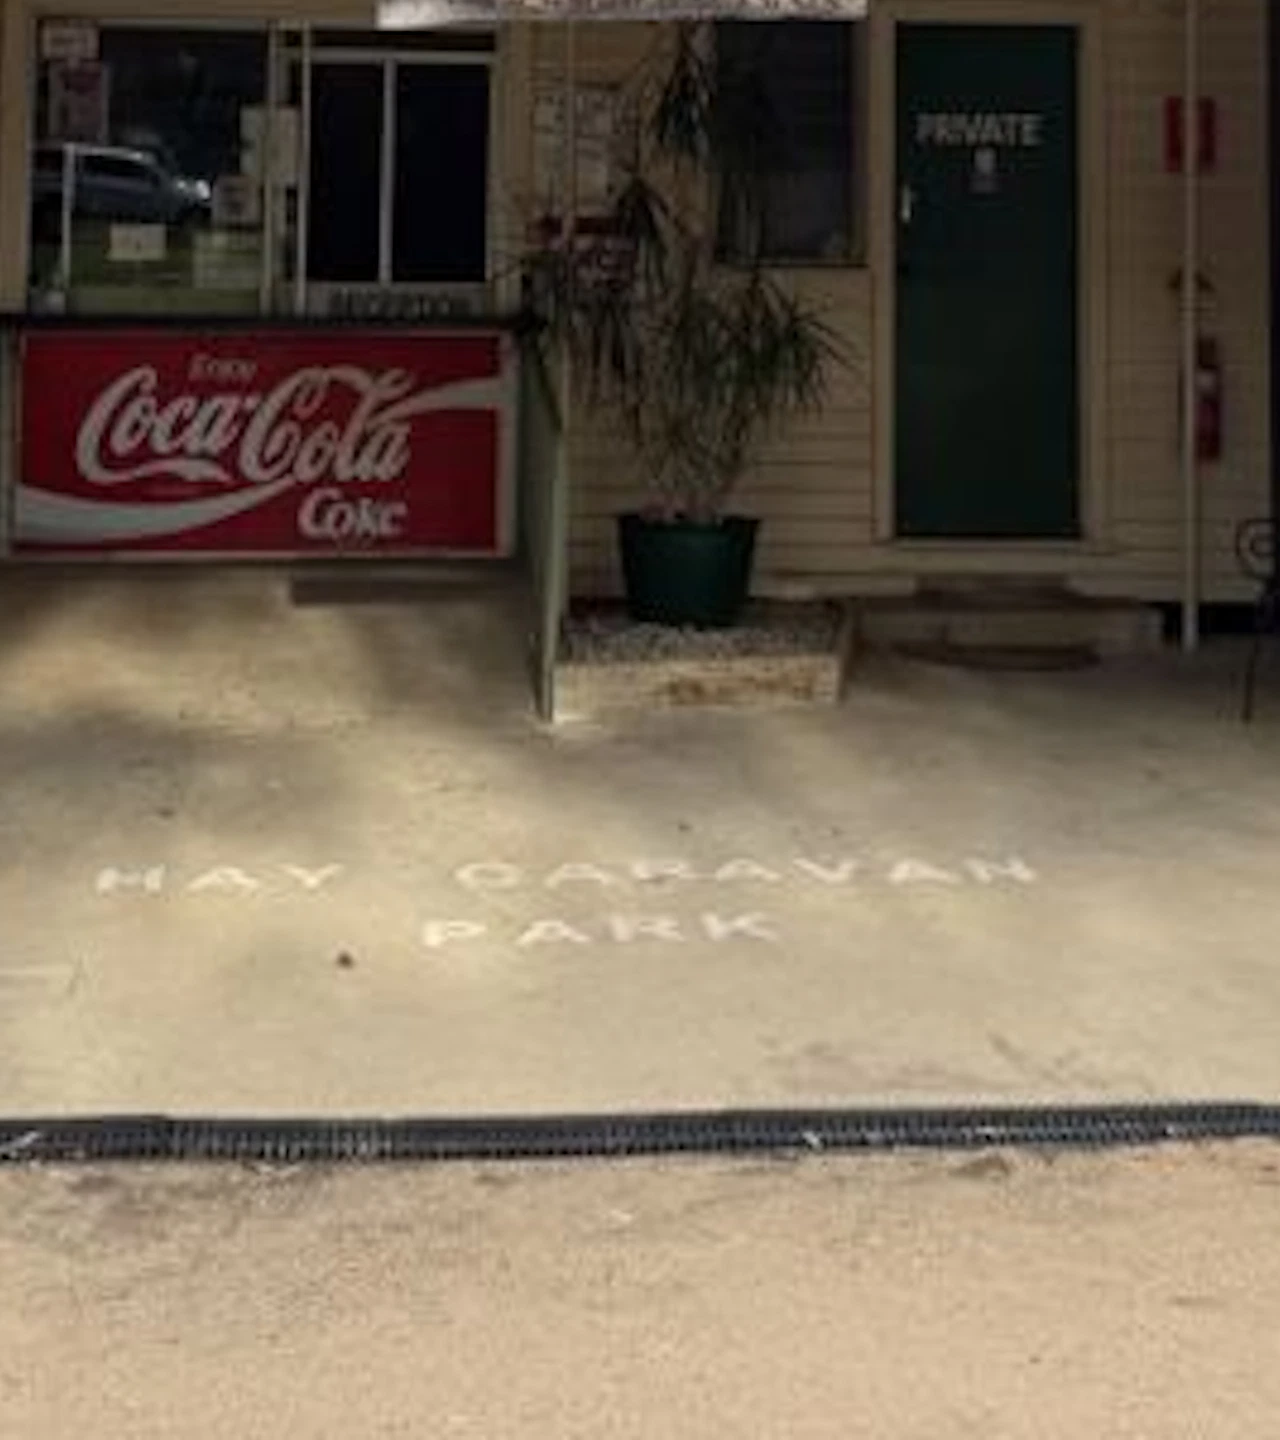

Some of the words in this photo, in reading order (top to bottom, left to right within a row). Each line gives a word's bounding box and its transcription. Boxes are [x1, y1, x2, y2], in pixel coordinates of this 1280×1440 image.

[916, 112, 1046, 146] PRIVATE
[296, 488, 408, 540] Coke
[96, 862, 342, 892] HAY
[456, 858, 1037, 888] CARAVAN
[422, 914, 782, 947] PARK
